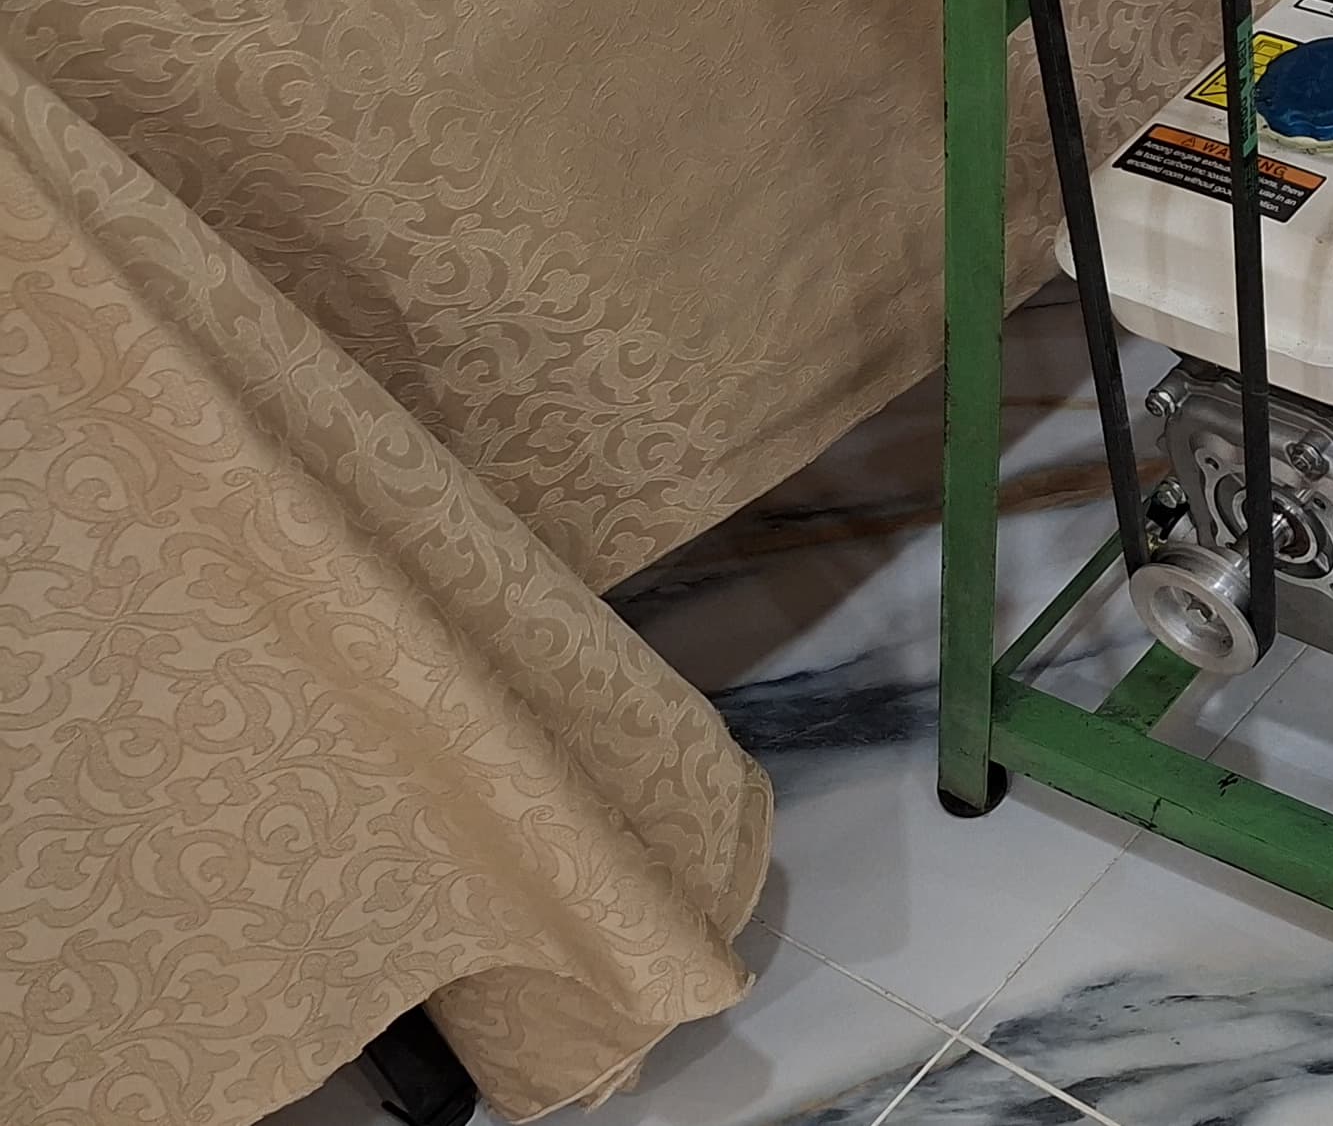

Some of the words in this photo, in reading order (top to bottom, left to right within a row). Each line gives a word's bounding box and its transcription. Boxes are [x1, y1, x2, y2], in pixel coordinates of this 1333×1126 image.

[1143, 140, 1173, 155] Among
[1173, 149, 1201, 163] engine
[1203, 142, 1288, 179] WANG
[1126, 157, 1162, 173] enclosed
[1162, 167, 1184, 179] room
[1184, 172, 1214, 190] without
[1143, 151, 1163, 163] toxic
[1163, 157, 1192, 172] carbon
[1259, 189, 1274, 199] use
[1275, 193, 1285, 202] in
[1285, 196, 1297, 206] an
